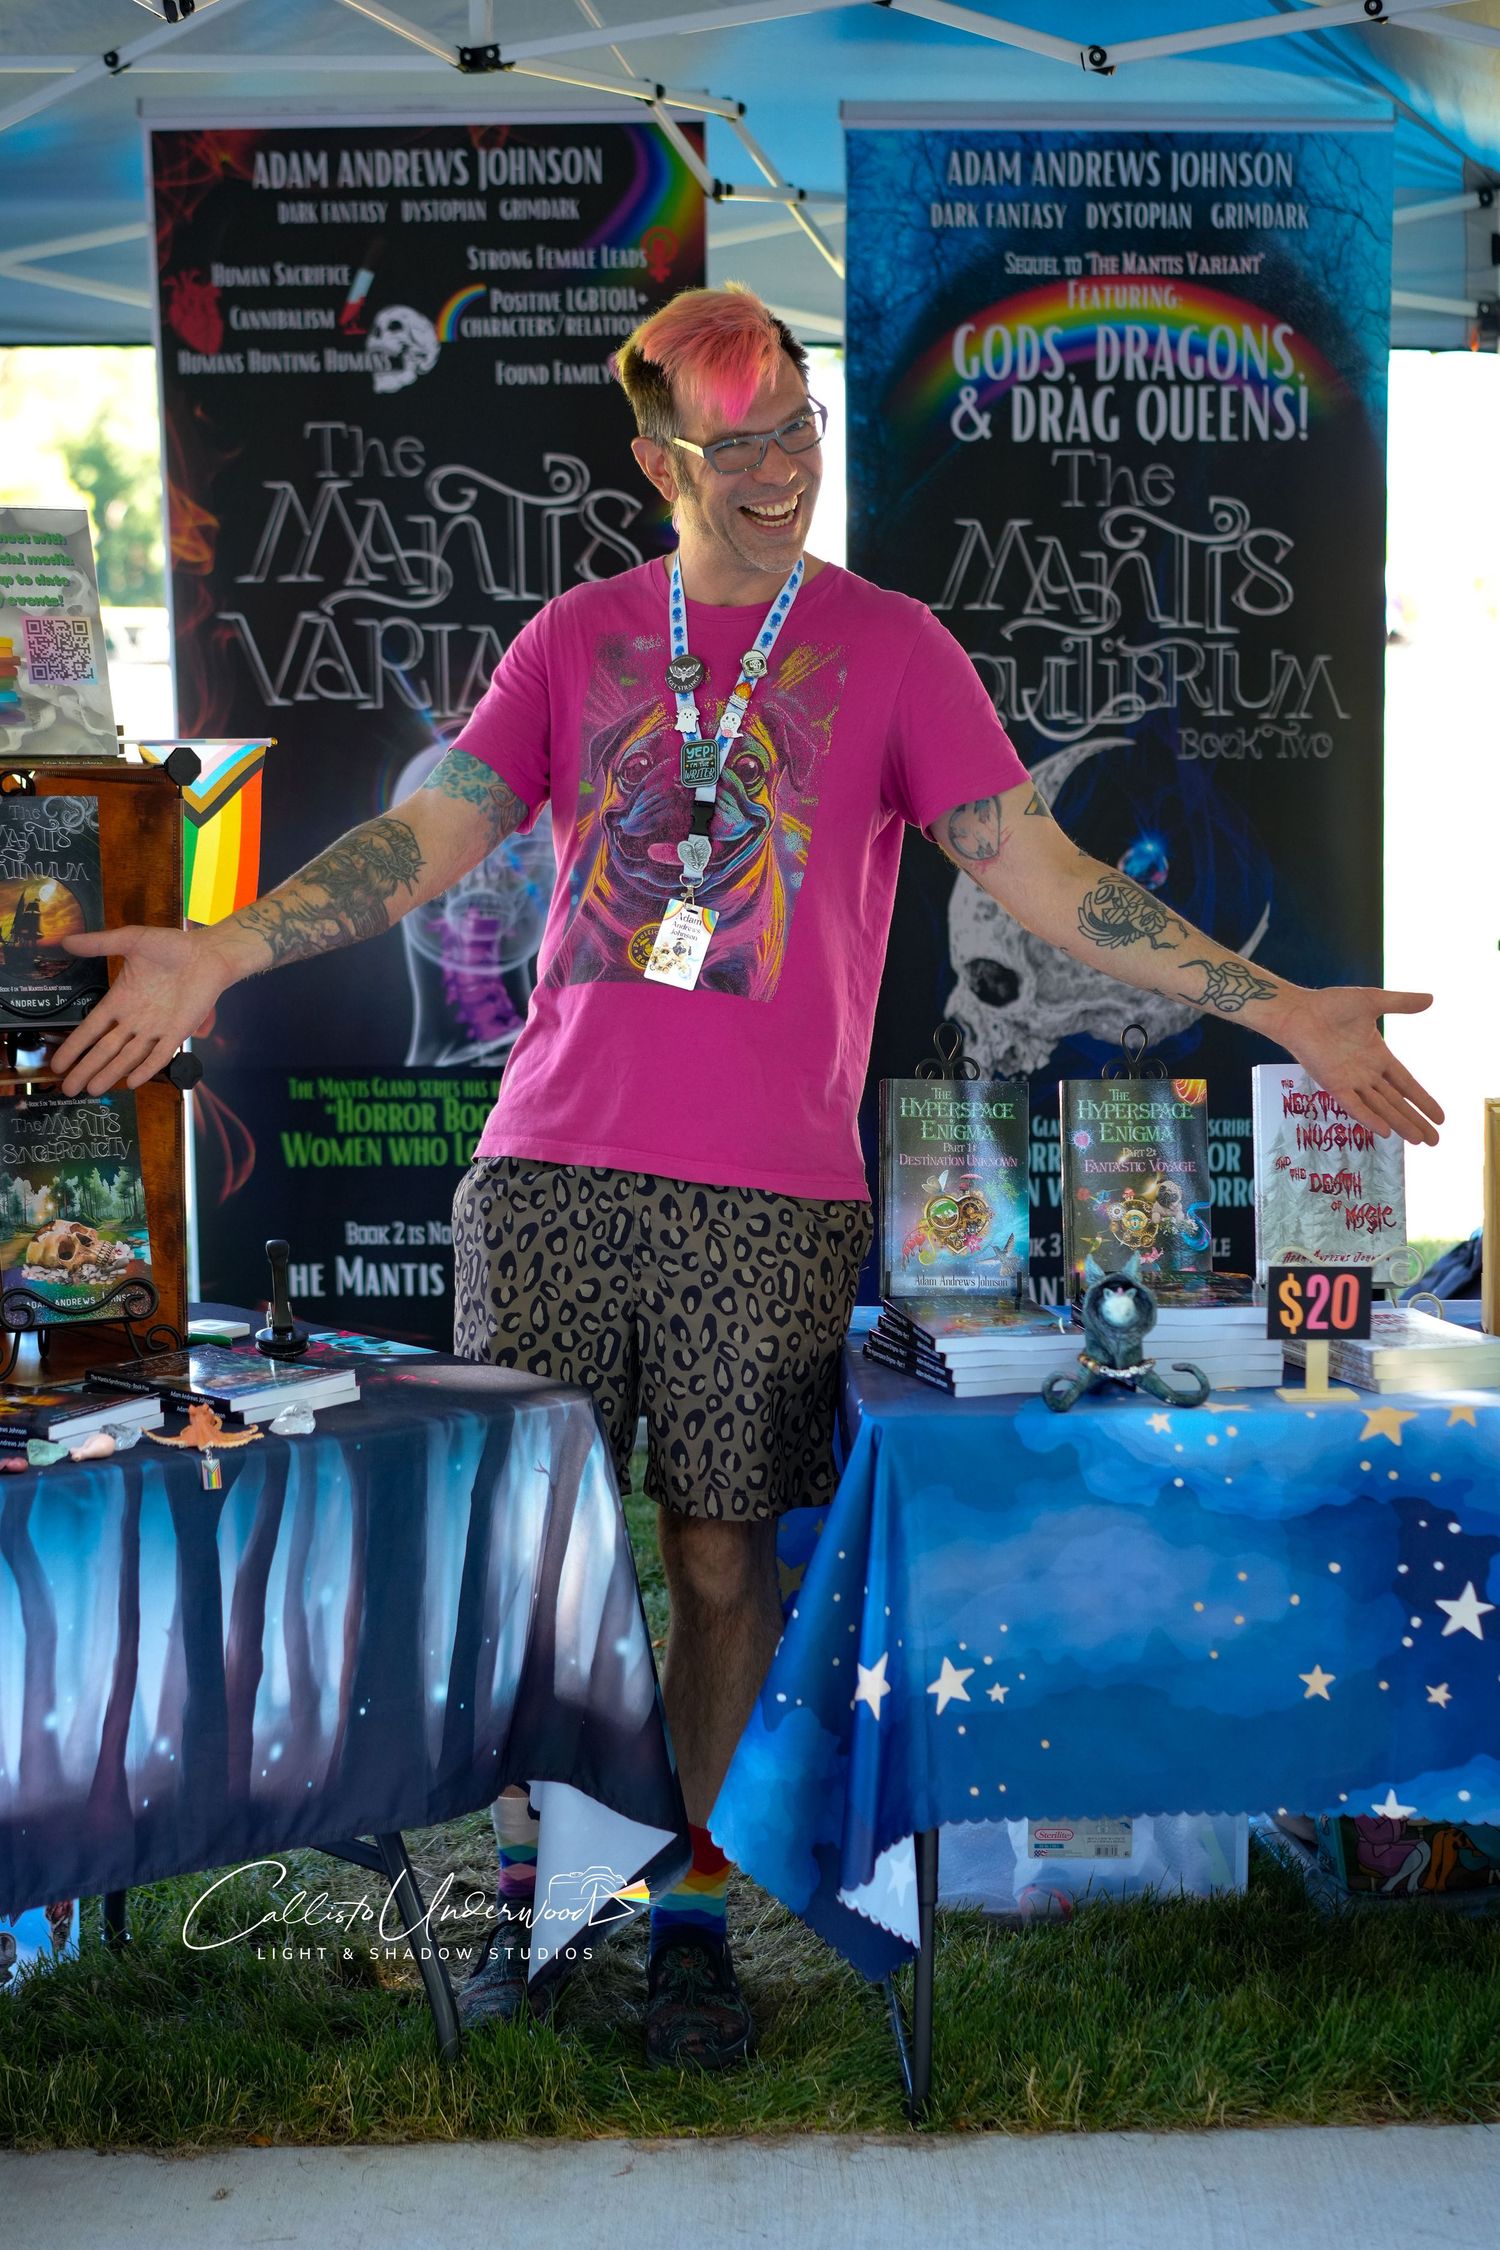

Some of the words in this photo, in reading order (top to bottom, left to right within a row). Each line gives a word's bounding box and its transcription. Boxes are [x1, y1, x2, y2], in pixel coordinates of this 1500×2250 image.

[252, 151, 329, 190] ADAM
[337, 148, 469, 189] ANDREWS
[478, 147, 603, 191] JOHNSON
[947, 151, 1022, 187] ADAM
[1032, 151, 1162, 187] ANDREWS
[1171, 151, 1294, 194] JOHNSON
[278, 201, 319, 225] DARK
[321, 201, 389, 225] FANTASY
[402, 200, 488, 223] DYSTOPIAN
[499, 198, 580, 222] GRIMDARK
[930, 203, 979, 230] DARK
[986, 203, 1067, 230] FANTASY
[1086, 203, 1193, 230] DYSTOPIAN
[1211, 203, 1309, 230] GRIMDARK
[1122, 251, 1184, 276] MANTIS
[952, 323, 1076, 384] GODS,
[951, 384, 991, 442] &
[1011, 385, 1120, 443] DRAG
[1137, 385, 1309, 446] QUEENS!
[931, 1087, 952, 1100] THE
[1109, 1088, 1130, 1101] THE
[900, 1097, 1016, 1119] HYPERSPACE
[1077, 1099, 1196, 1120] HYPERSPACE
[921, 1119, 997, 1141] ENIGMA
[1100, 1120, 1176, 1143] ENIGMA
[280, 1131, 383, 1168] WOMEN
[388, 1136, 448, 1167] WHO
[1309, 1168, 1362, 1201] DEATH
[392, 1221, 405, 1245] 2
[288, 1263, 326, 1297] HE
[335, 1255, 446, 1297] MANTIS
[916, 1274, 936, 1286] Adam
[940, 1274, 976, 1286] Andrews
[977, 1274, 1008, 1288] Johnson
[1278, 1272, 1360, 1335] $20
